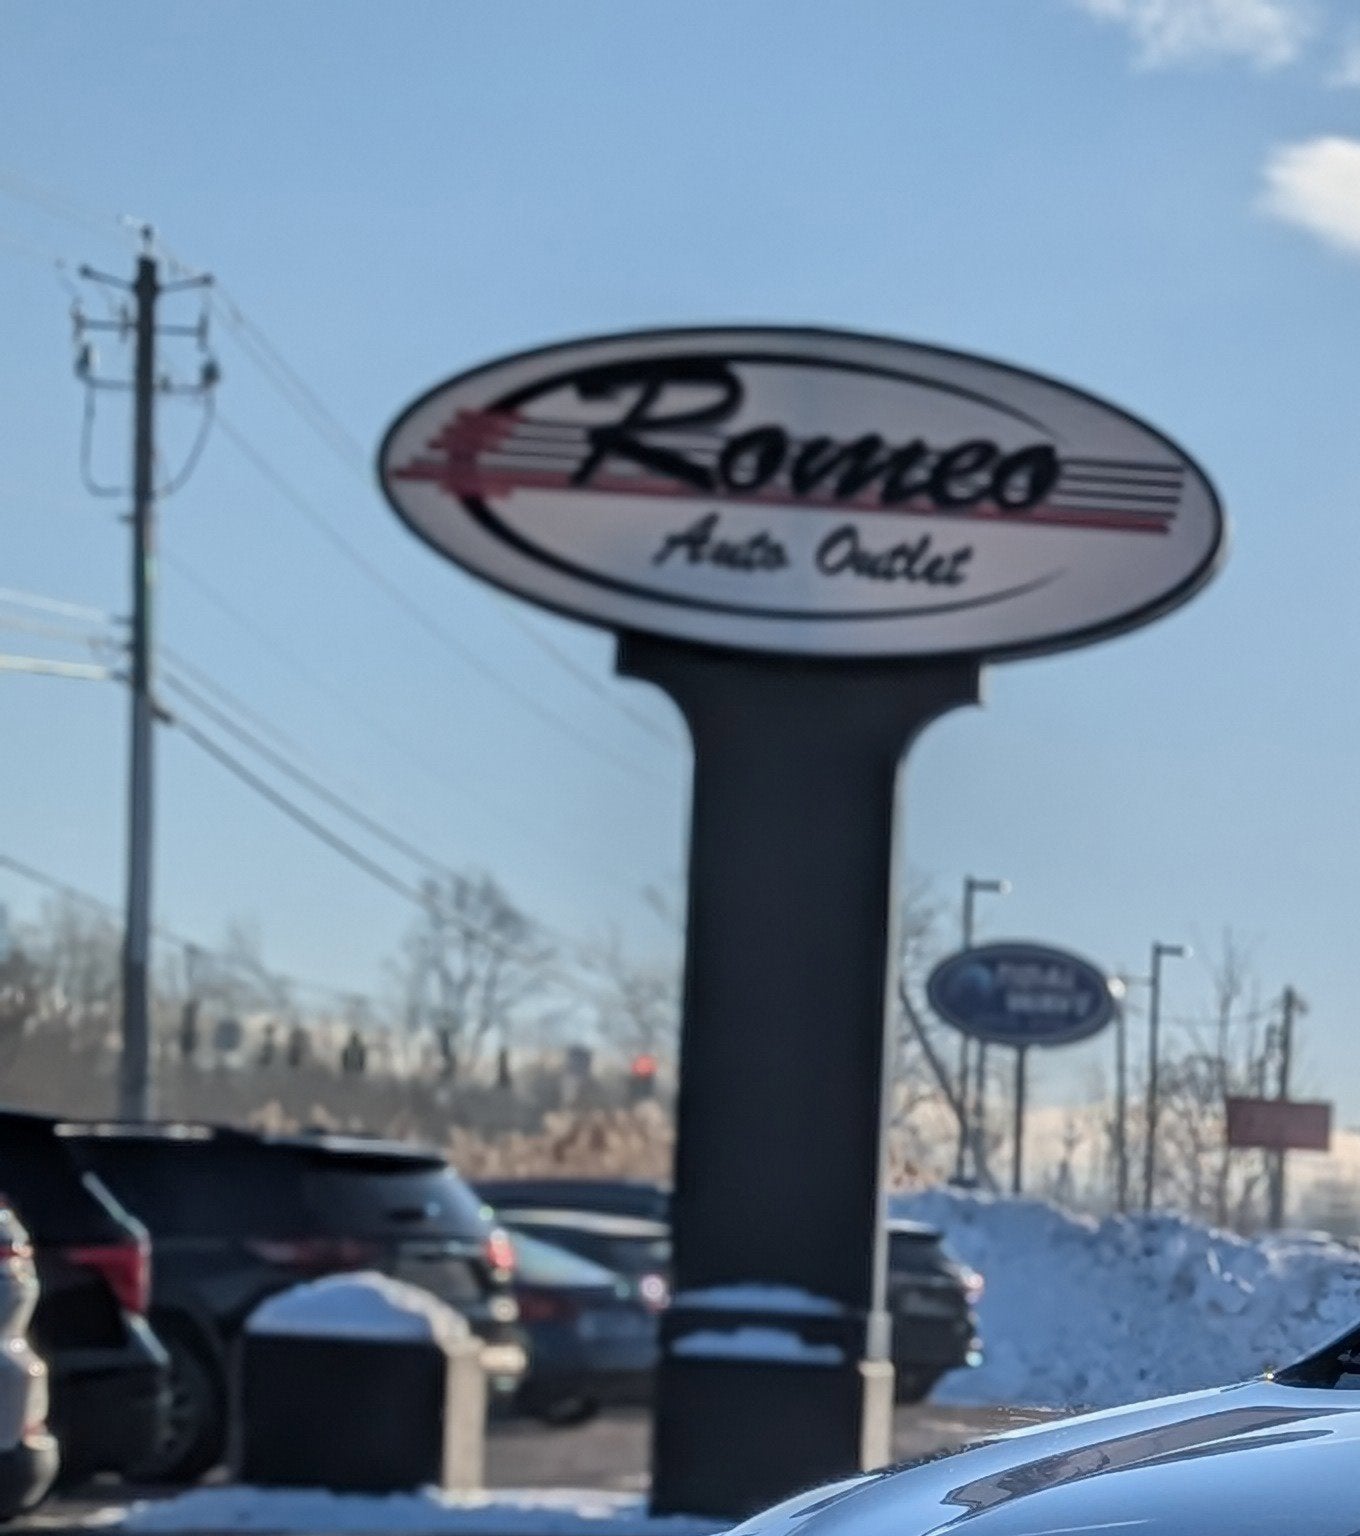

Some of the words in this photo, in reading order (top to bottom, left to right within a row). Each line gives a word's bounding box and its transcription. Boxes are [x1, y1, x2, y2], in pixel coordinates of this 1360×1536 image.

[570, 354, 1060, 510] Romeo
[652, 510, 791, 573] Auto
[814, 522, 976, 587] Outlet
